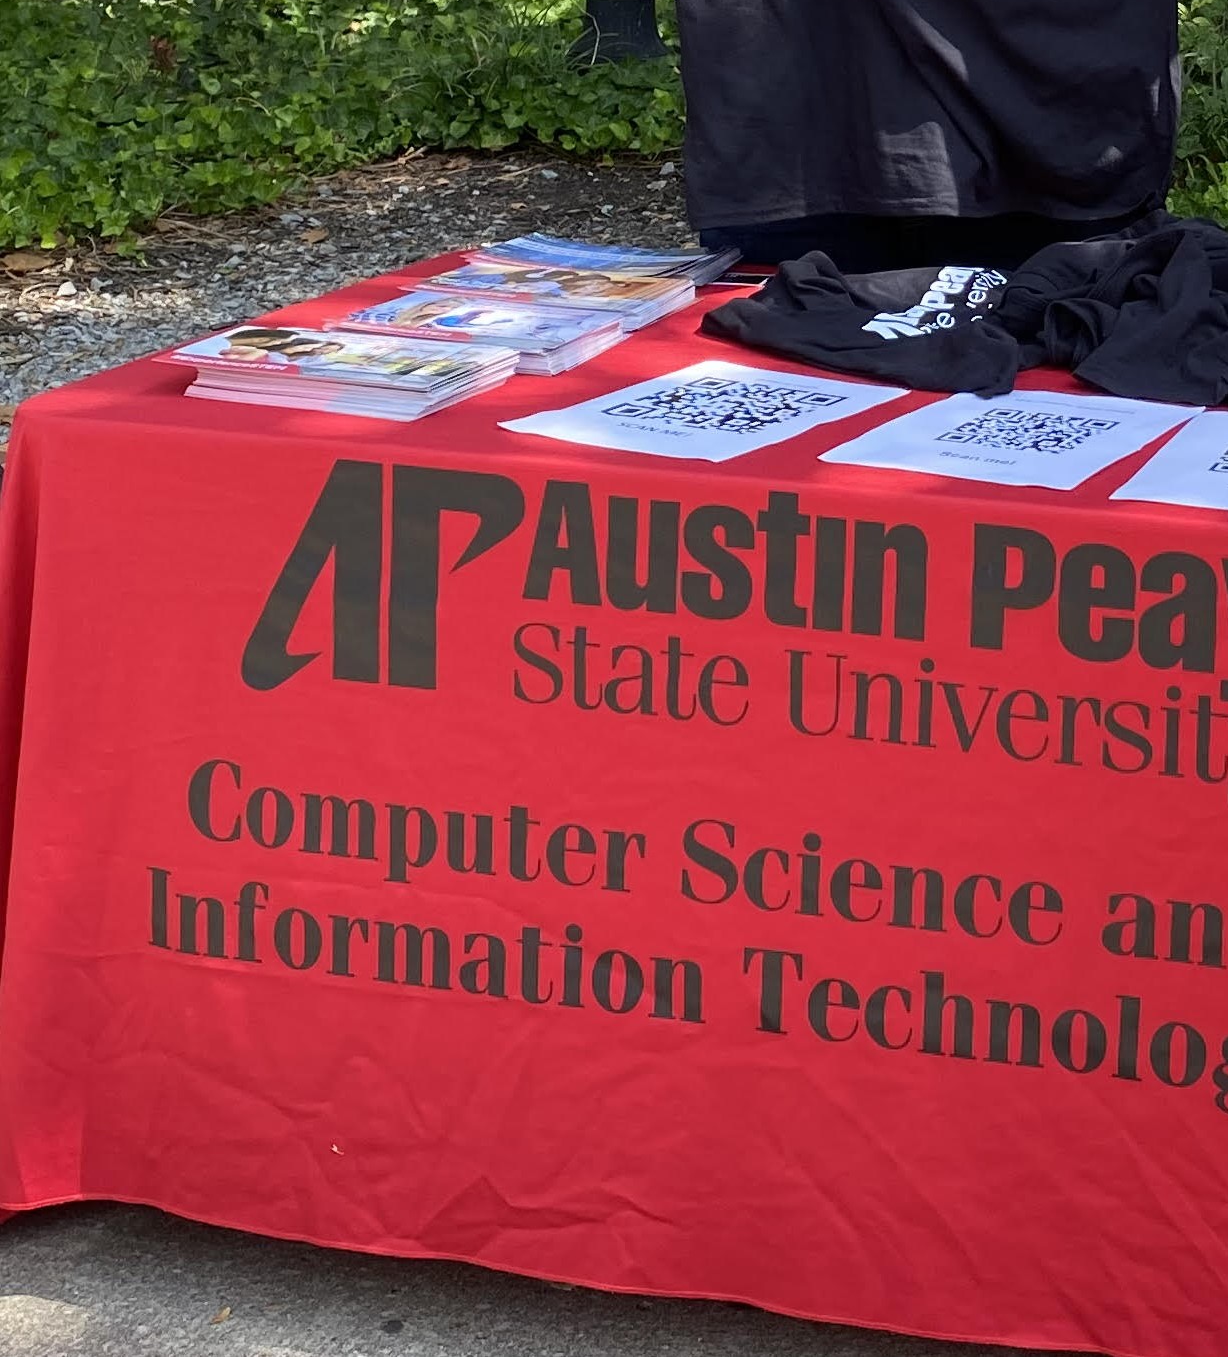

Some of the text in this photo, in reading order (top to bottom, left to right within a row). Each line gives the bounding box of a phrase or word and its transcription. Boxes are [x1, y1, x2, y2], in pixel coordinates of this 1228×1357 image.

[939, 451, 980, 461] Scan
[523, 480, 928, 641] Austin
[514, 624, 749, 726] State
[188, 760, 646, 892] Computer
[682, 820, 1063, 945] Science
[149, 868, 705, 1023] Information
